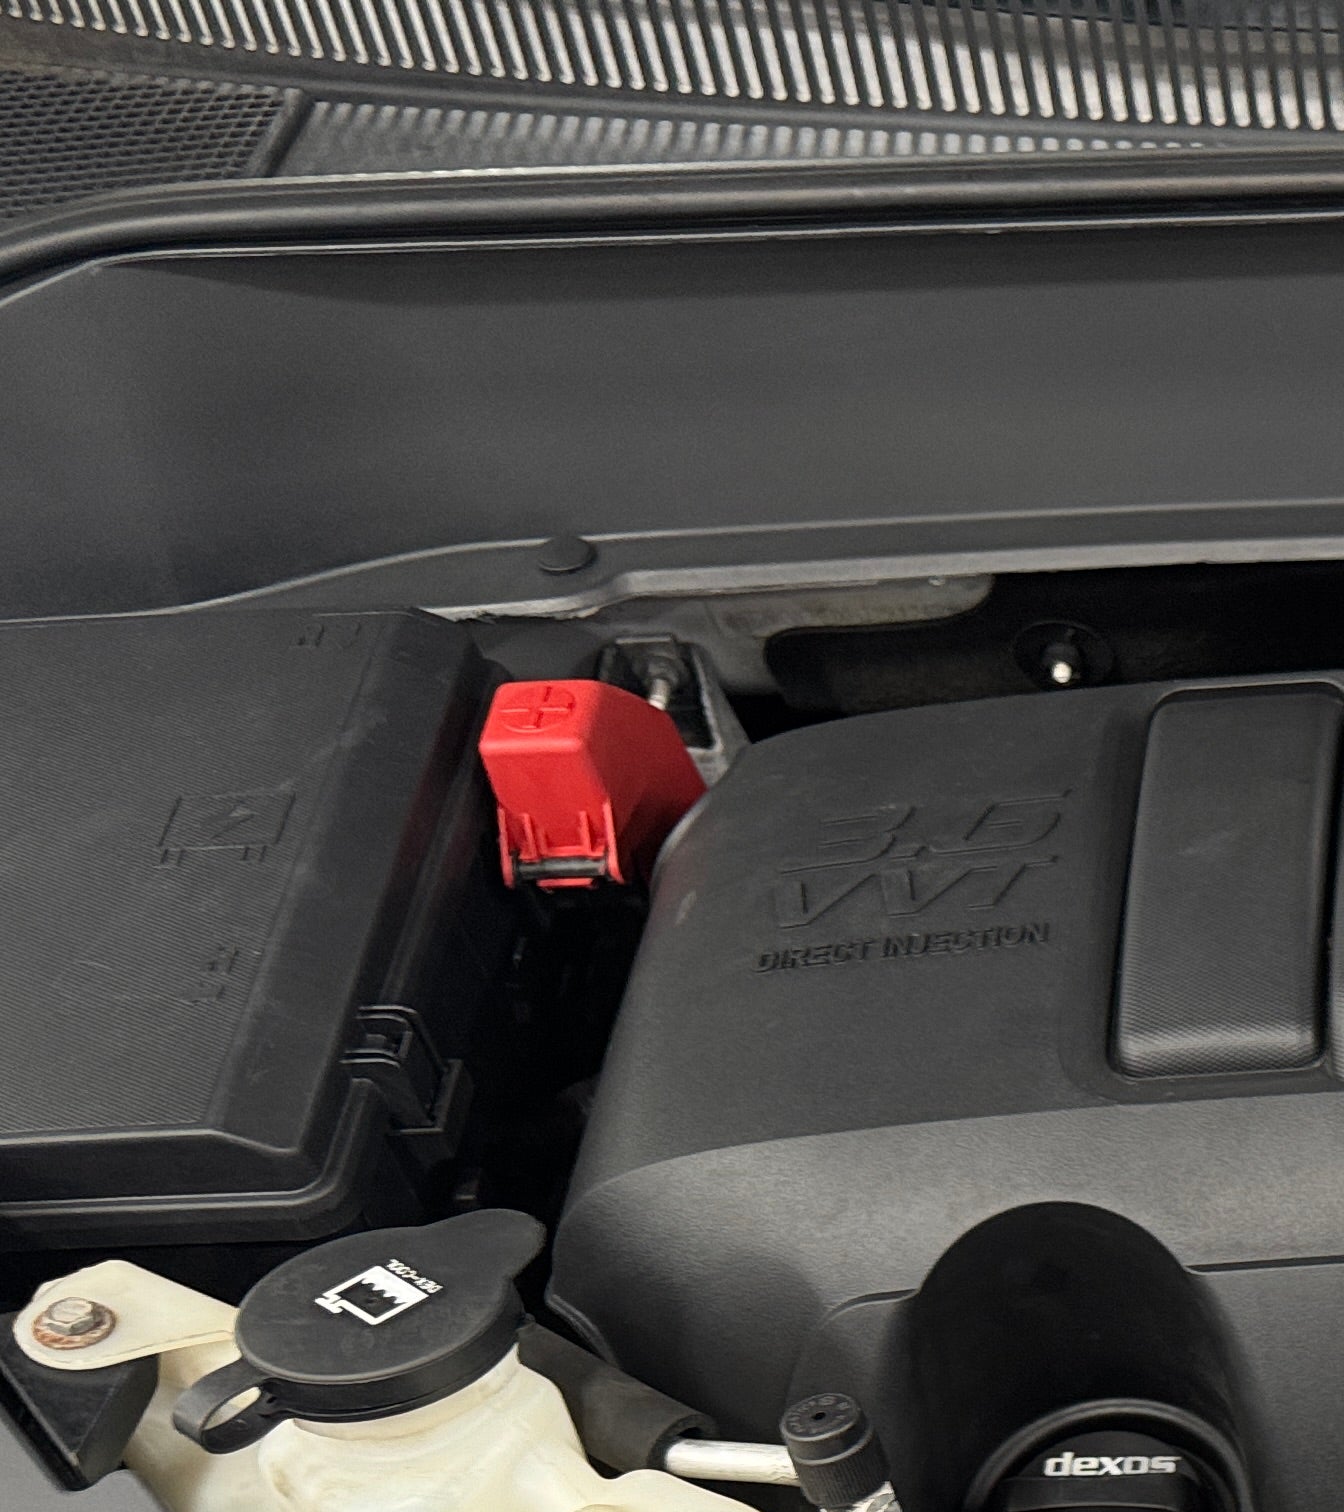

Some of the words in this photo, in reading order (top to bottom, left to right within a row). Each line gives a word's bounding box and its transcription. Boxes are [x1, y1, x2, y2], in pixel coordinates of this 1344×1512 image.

[769, 851, 1061, 931] VVT
[752, 937, 876, 974] DIRECT
[880, 921, 1052, 960] INJECTION
[1043, 1451, 1182, 1477] dexos
